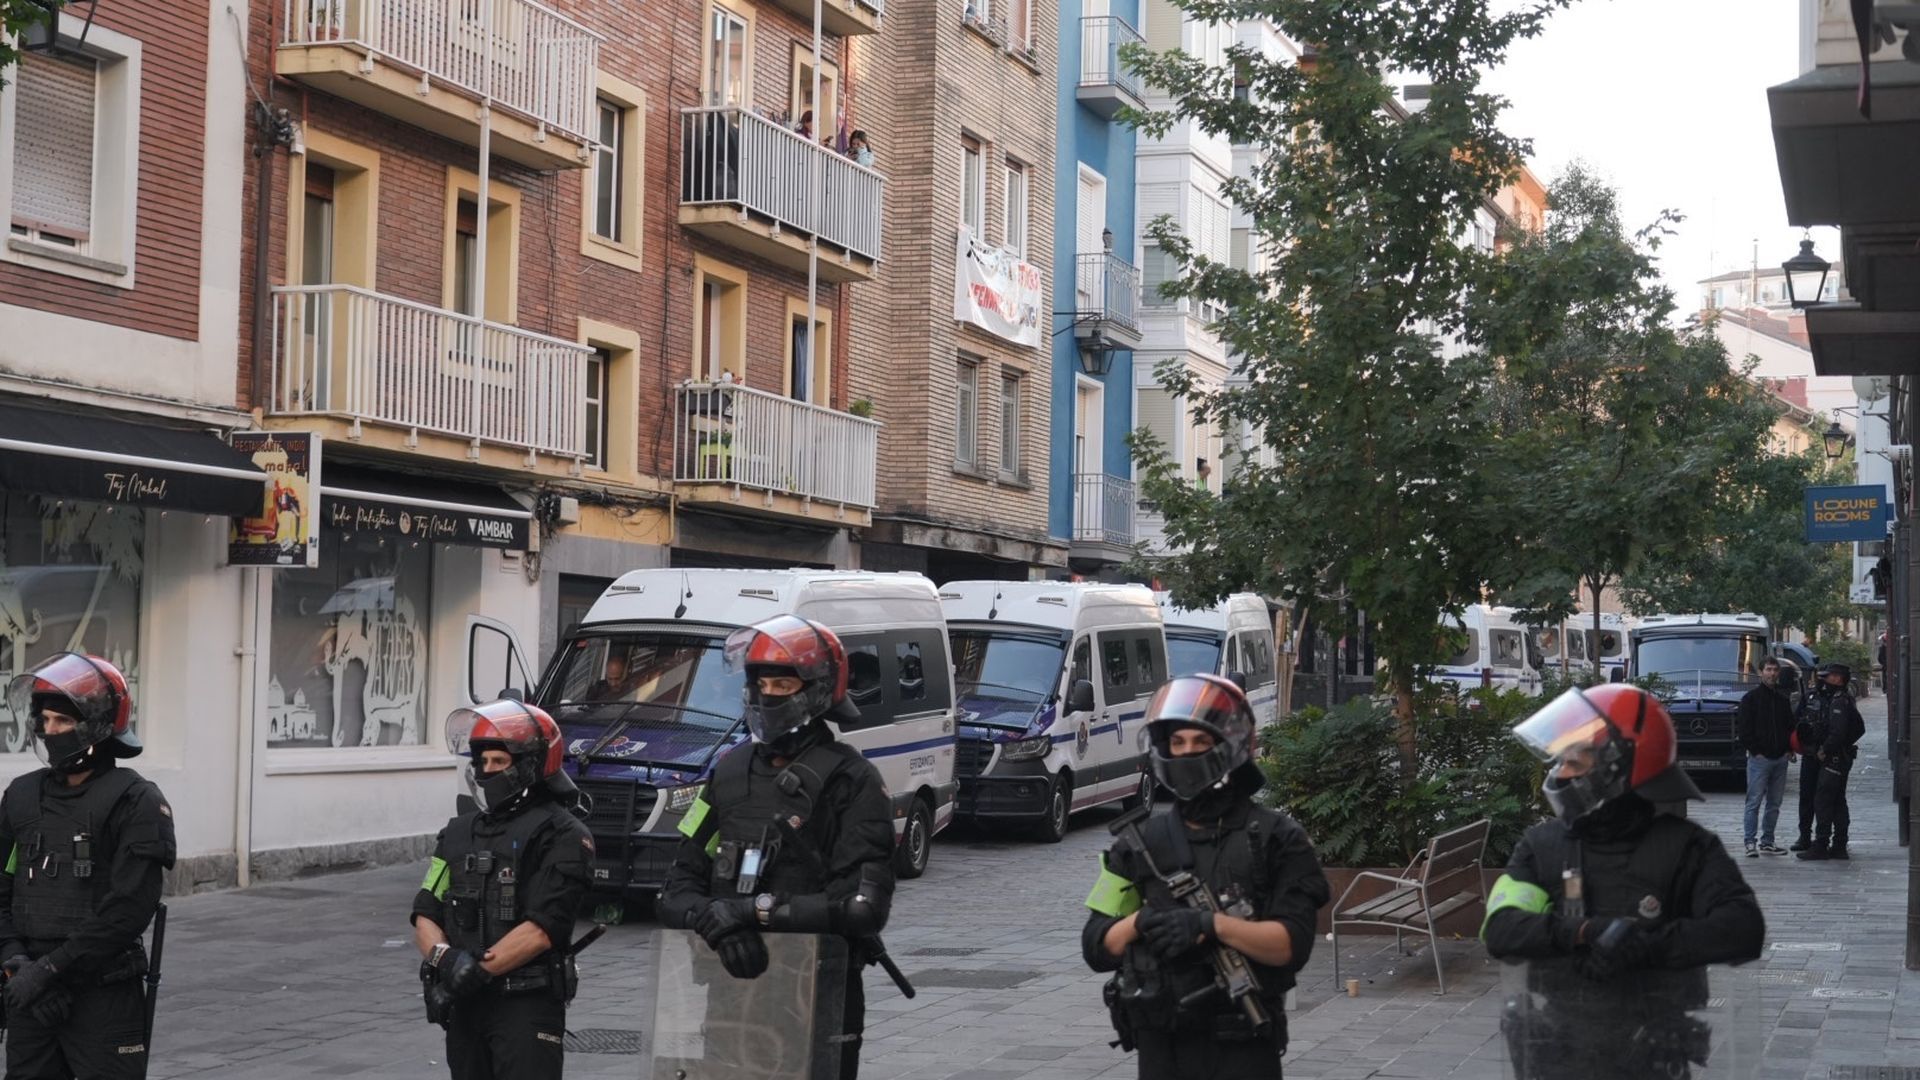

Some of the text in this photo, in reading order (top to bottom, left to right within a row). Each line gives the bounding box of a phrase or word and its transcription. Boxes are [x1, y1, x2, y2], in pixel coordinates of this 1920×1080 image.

[104, 472, 168, 501] Taj Mahal
[1814, 498, 1877, 510] LOGUNE
[1815, 511, 1870, 521] ROOMS
[477, 519, 515, 540] AMBAR
[373, 657, 414, 699] AWAY
